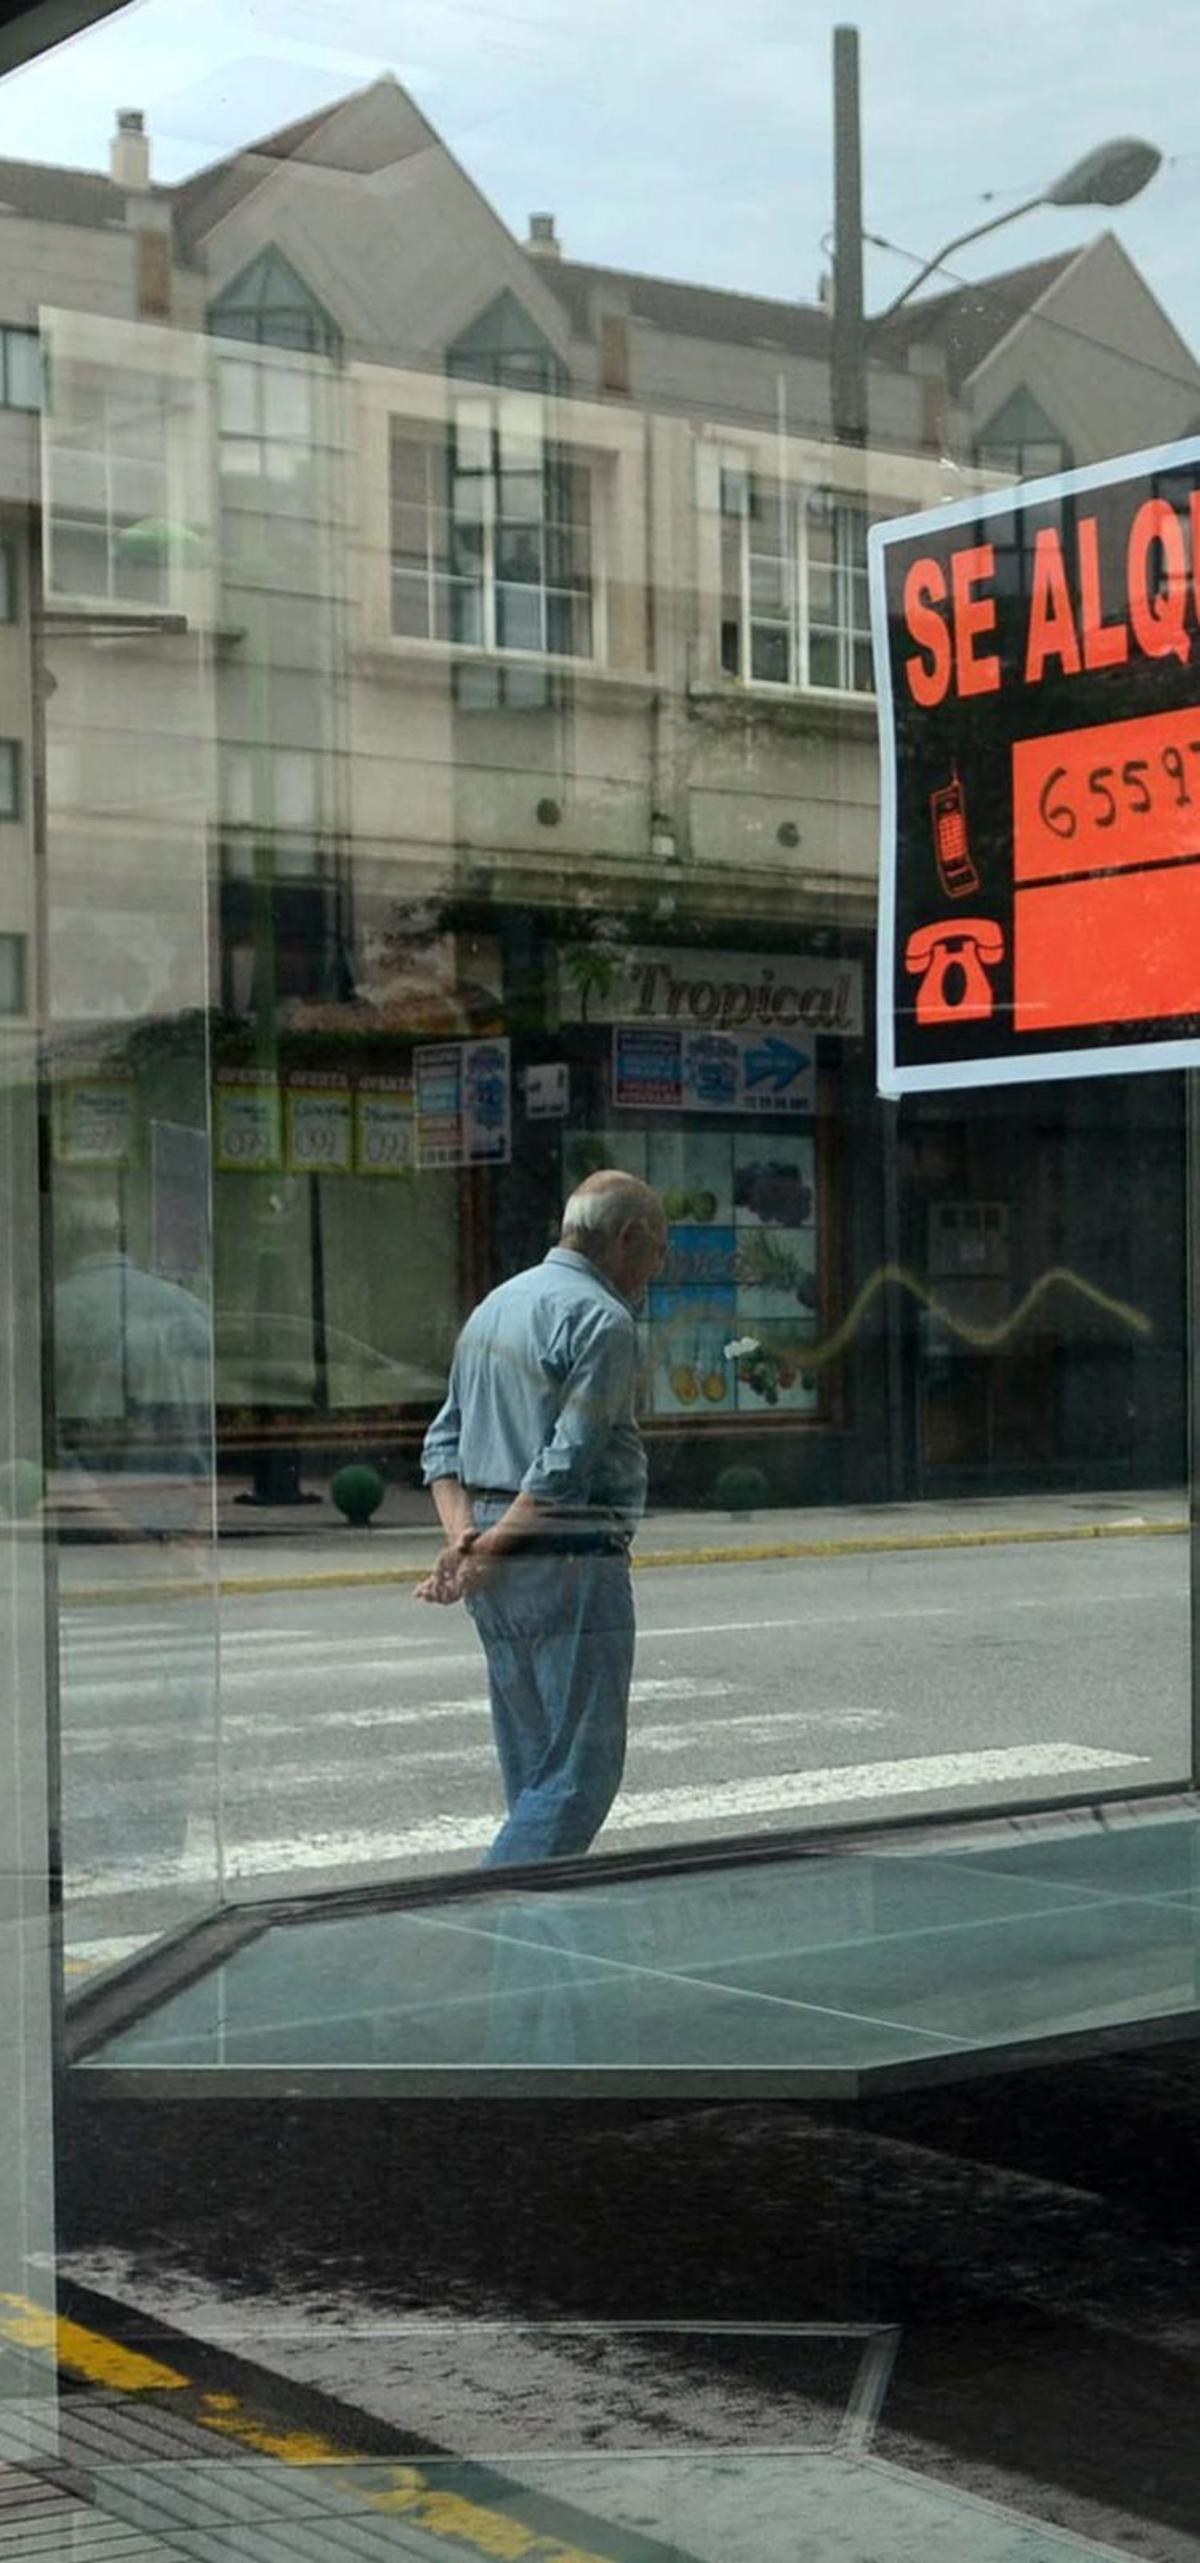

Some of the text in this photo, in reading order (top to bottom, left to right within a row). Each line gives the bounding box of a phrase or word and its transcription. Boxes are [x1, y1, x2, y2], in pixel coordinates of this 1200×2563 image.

[904, 489, 1200, 707] SE ALQ
[1039, 740, 1200, 839] 6559
[629, 962, 853, 1030] Tropical
